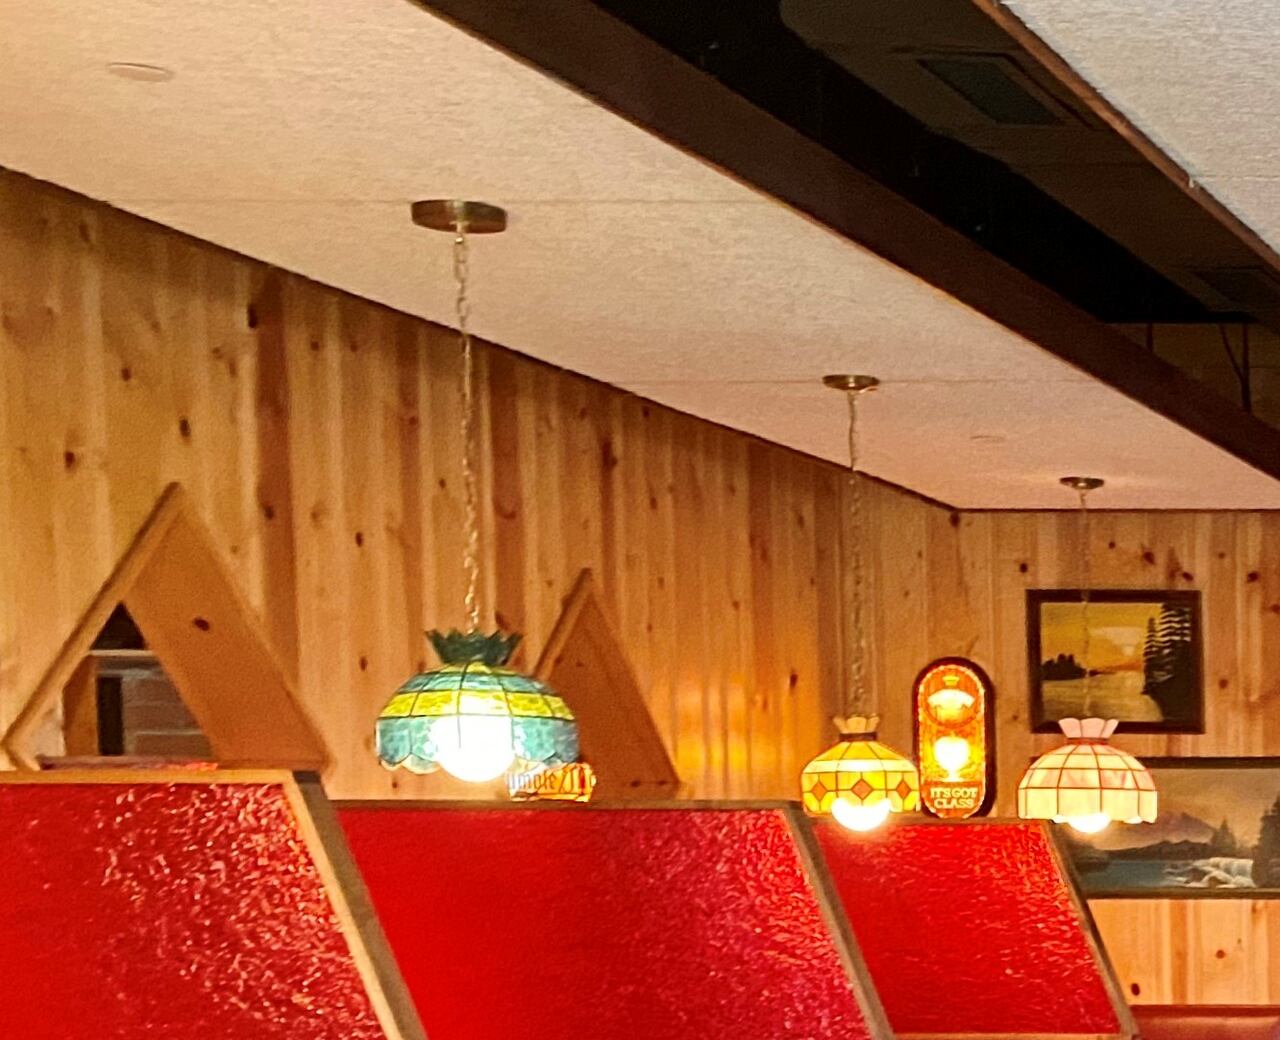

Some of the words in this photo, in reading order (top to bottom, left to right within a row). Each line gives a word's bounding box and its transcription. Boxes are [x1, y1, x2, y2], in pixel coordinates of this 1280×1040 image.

[930, 787, 951, 798] IT'S
[951, 787, 978, 798] GOT
[934, 798, 975, 809] CLASS
